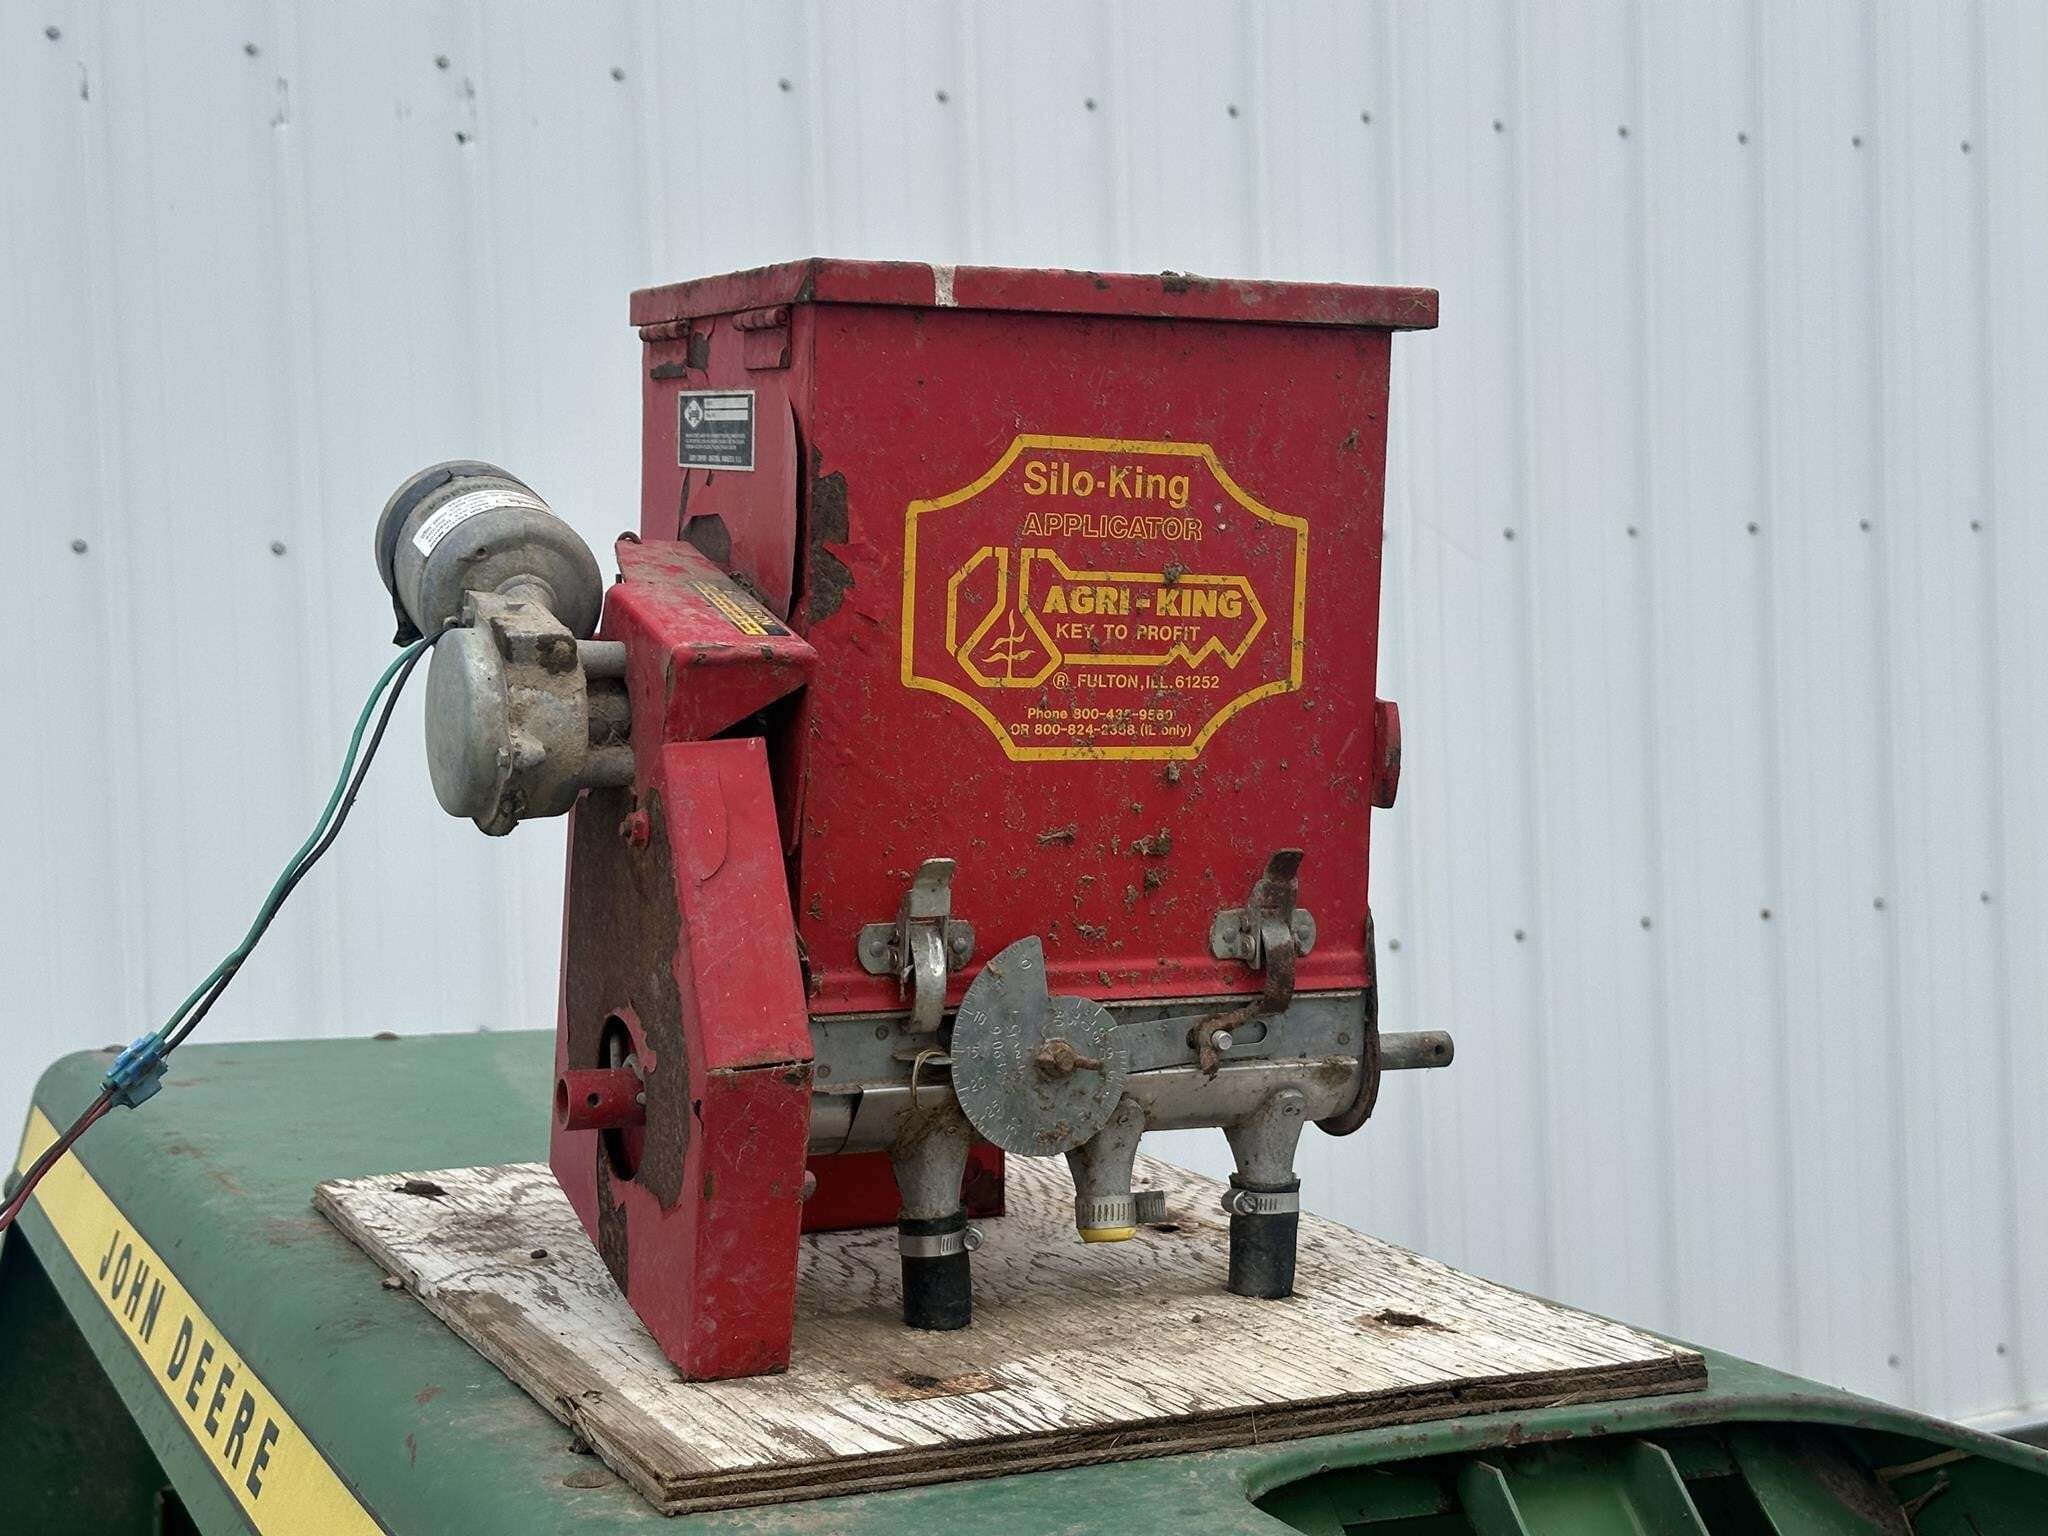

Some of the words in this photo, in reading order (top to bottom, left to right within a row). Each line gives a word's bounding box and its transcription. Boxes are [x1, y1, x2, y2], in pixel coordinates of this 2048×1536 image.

[1023, 461, 1189, 508] Silo-King
[1022, 512, 1202, 540] APPLICATOR
[1056, 624, 1094, 640] KEY
[1104, 624, 1127, 640] TO
[1136, 626, 1200, 641] PROFIT
[1175, 675, 1219, 689] 61252
[1028, 708, 1067, 719] Phone
[1011, 724, 1029, 735] OR
[1162, 724, 1191, 737] only)
[98, 1229, 167, 1345] JOHN
[167, 1314, 280, 1501] DEERE
